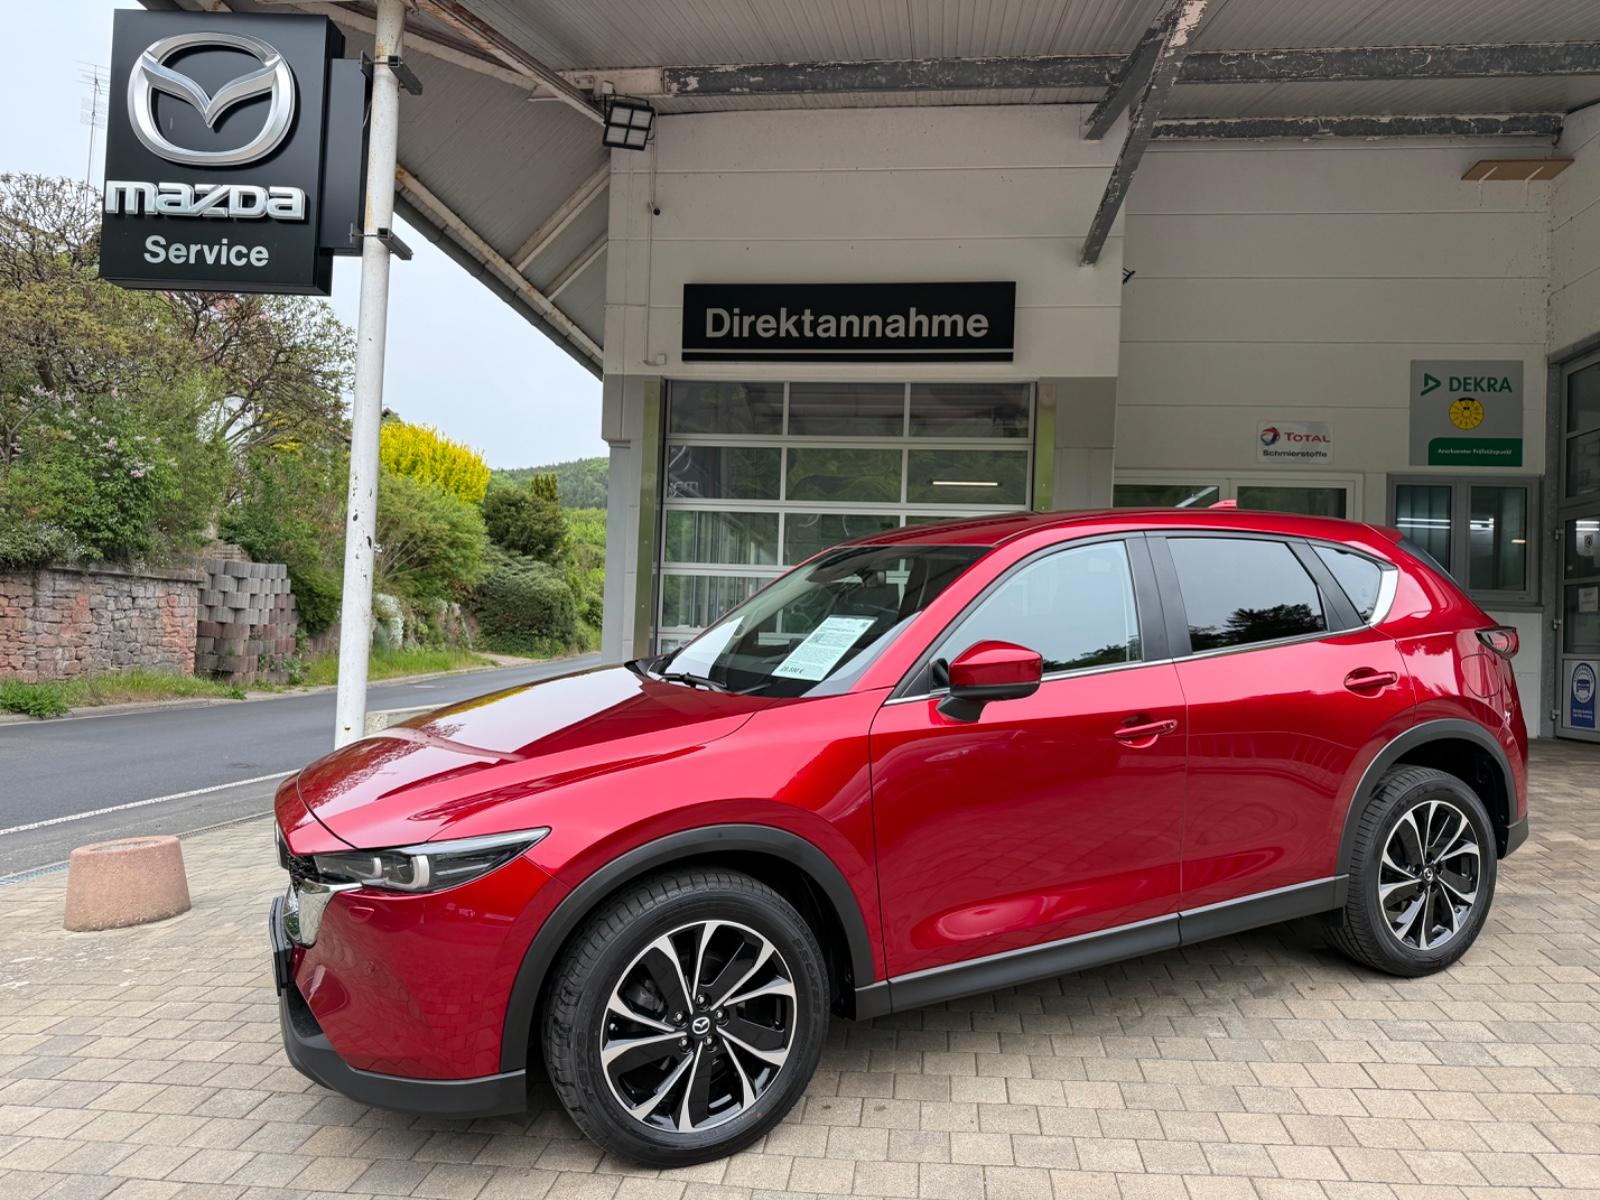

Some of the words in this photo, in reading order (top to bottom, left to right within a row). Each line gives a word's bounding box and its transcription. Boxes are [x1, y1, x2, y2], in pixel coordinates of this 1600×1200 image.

[144, 235, 269, 267] Service
[705, 307, 989, 338] Direktannahme
[1448, 376, 1512, 393] DEKRA
[1284, 431, 1331, 443] TOTAL
[1263, 449, 1328, 458] Schmierstoffe
